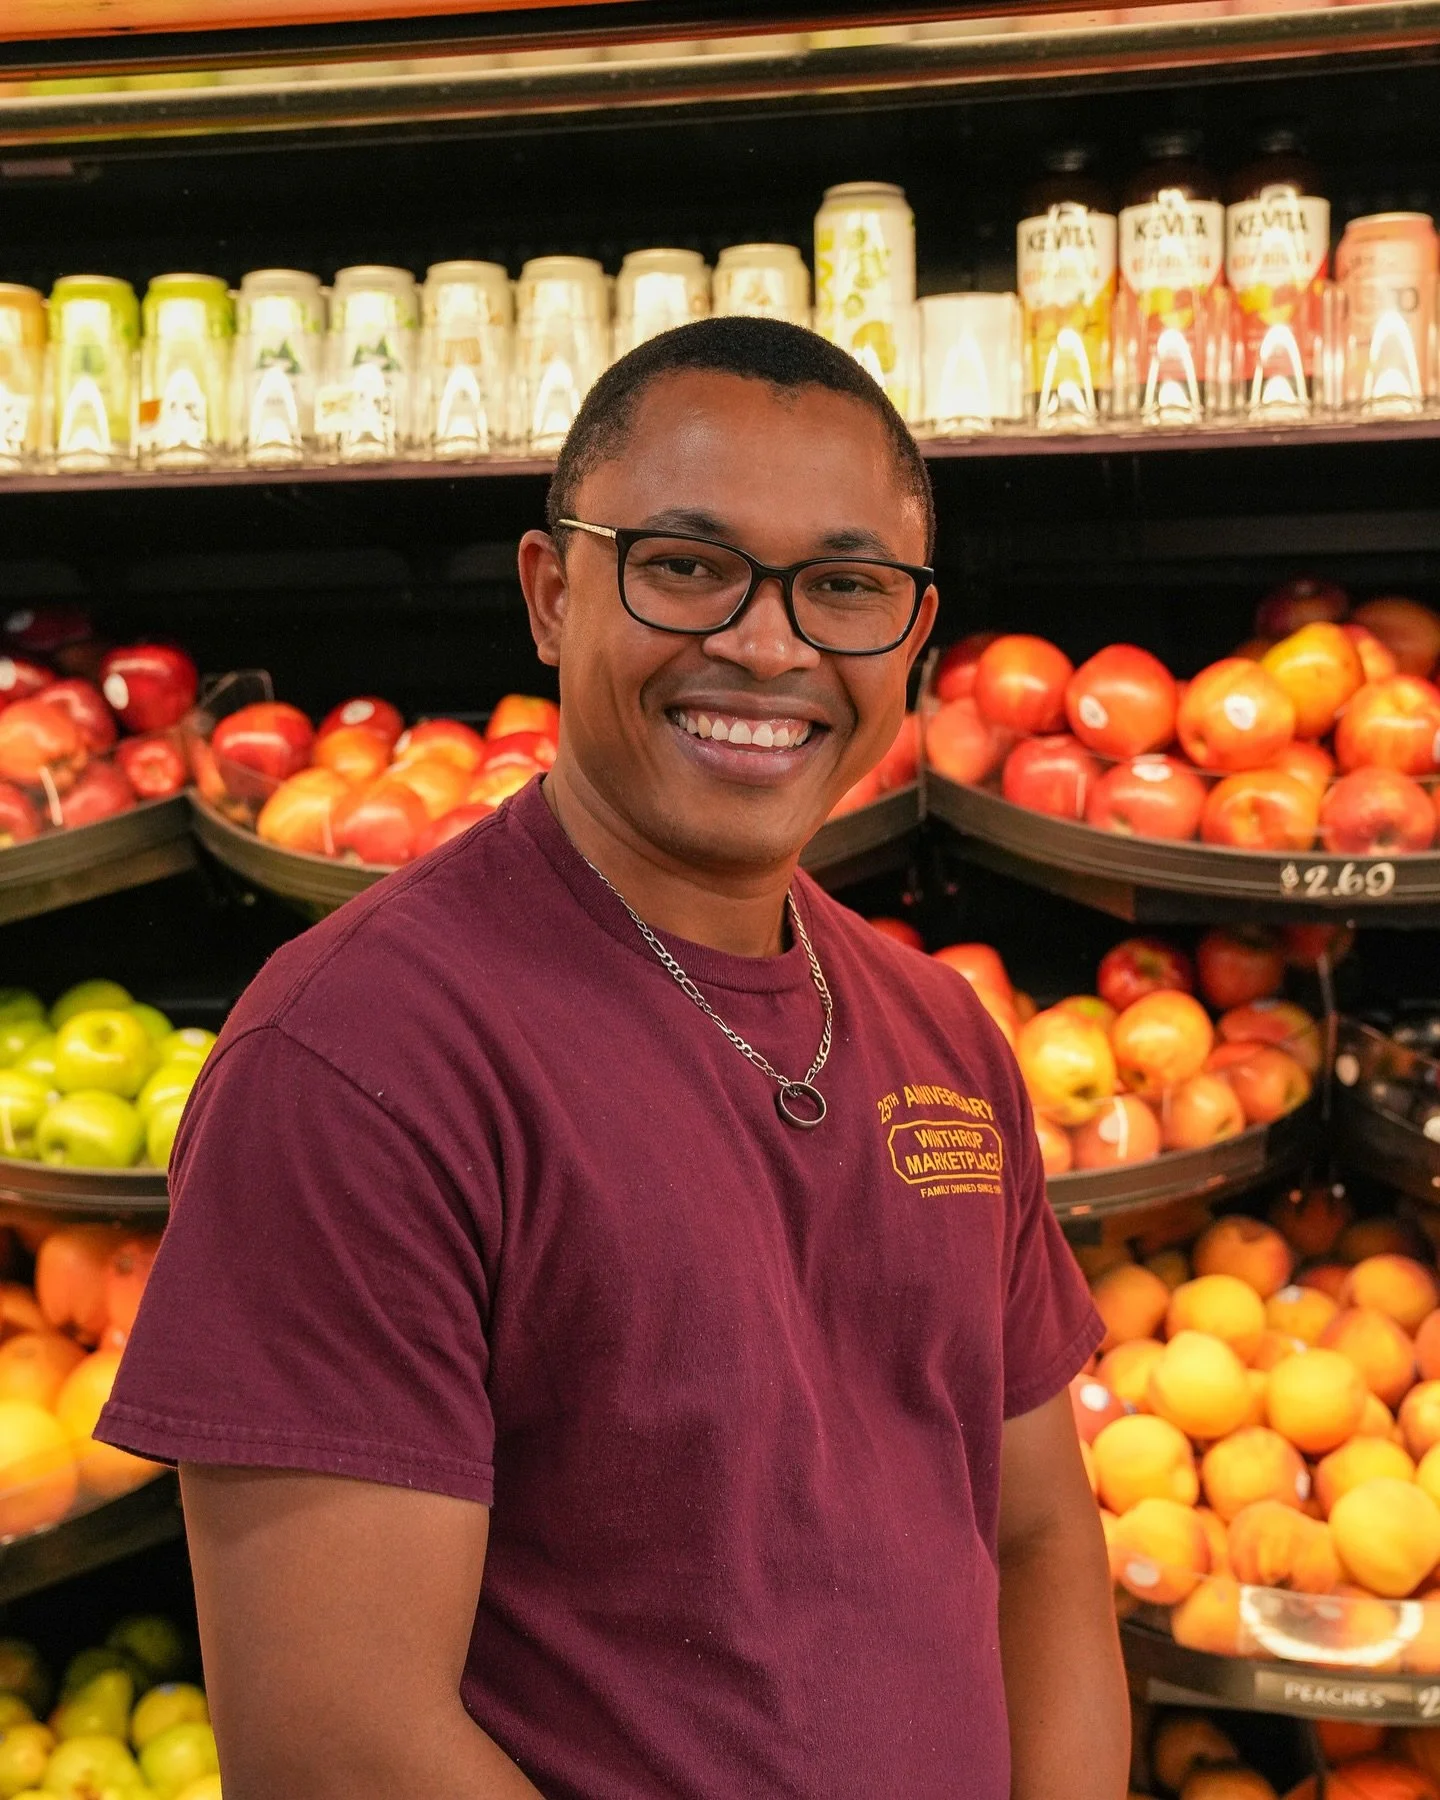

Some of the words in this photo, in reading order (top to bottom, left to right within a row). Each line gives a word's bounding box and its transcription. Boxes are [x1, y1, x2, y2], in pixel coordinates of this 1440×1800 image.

[877, 1092, 900, 1125] 25TH
[914, 1129, 983, 1149] WINTHROP
[905, 1151, 1000, 1175] MARKETPLACE
[920, 1184, 950, 1198] FAMILY
[950, 1183, 977, 1194] OWNED
[976, 1183, 994, 1194] SINCE
[1284, 1681, 1386, 1708] PEACHES
